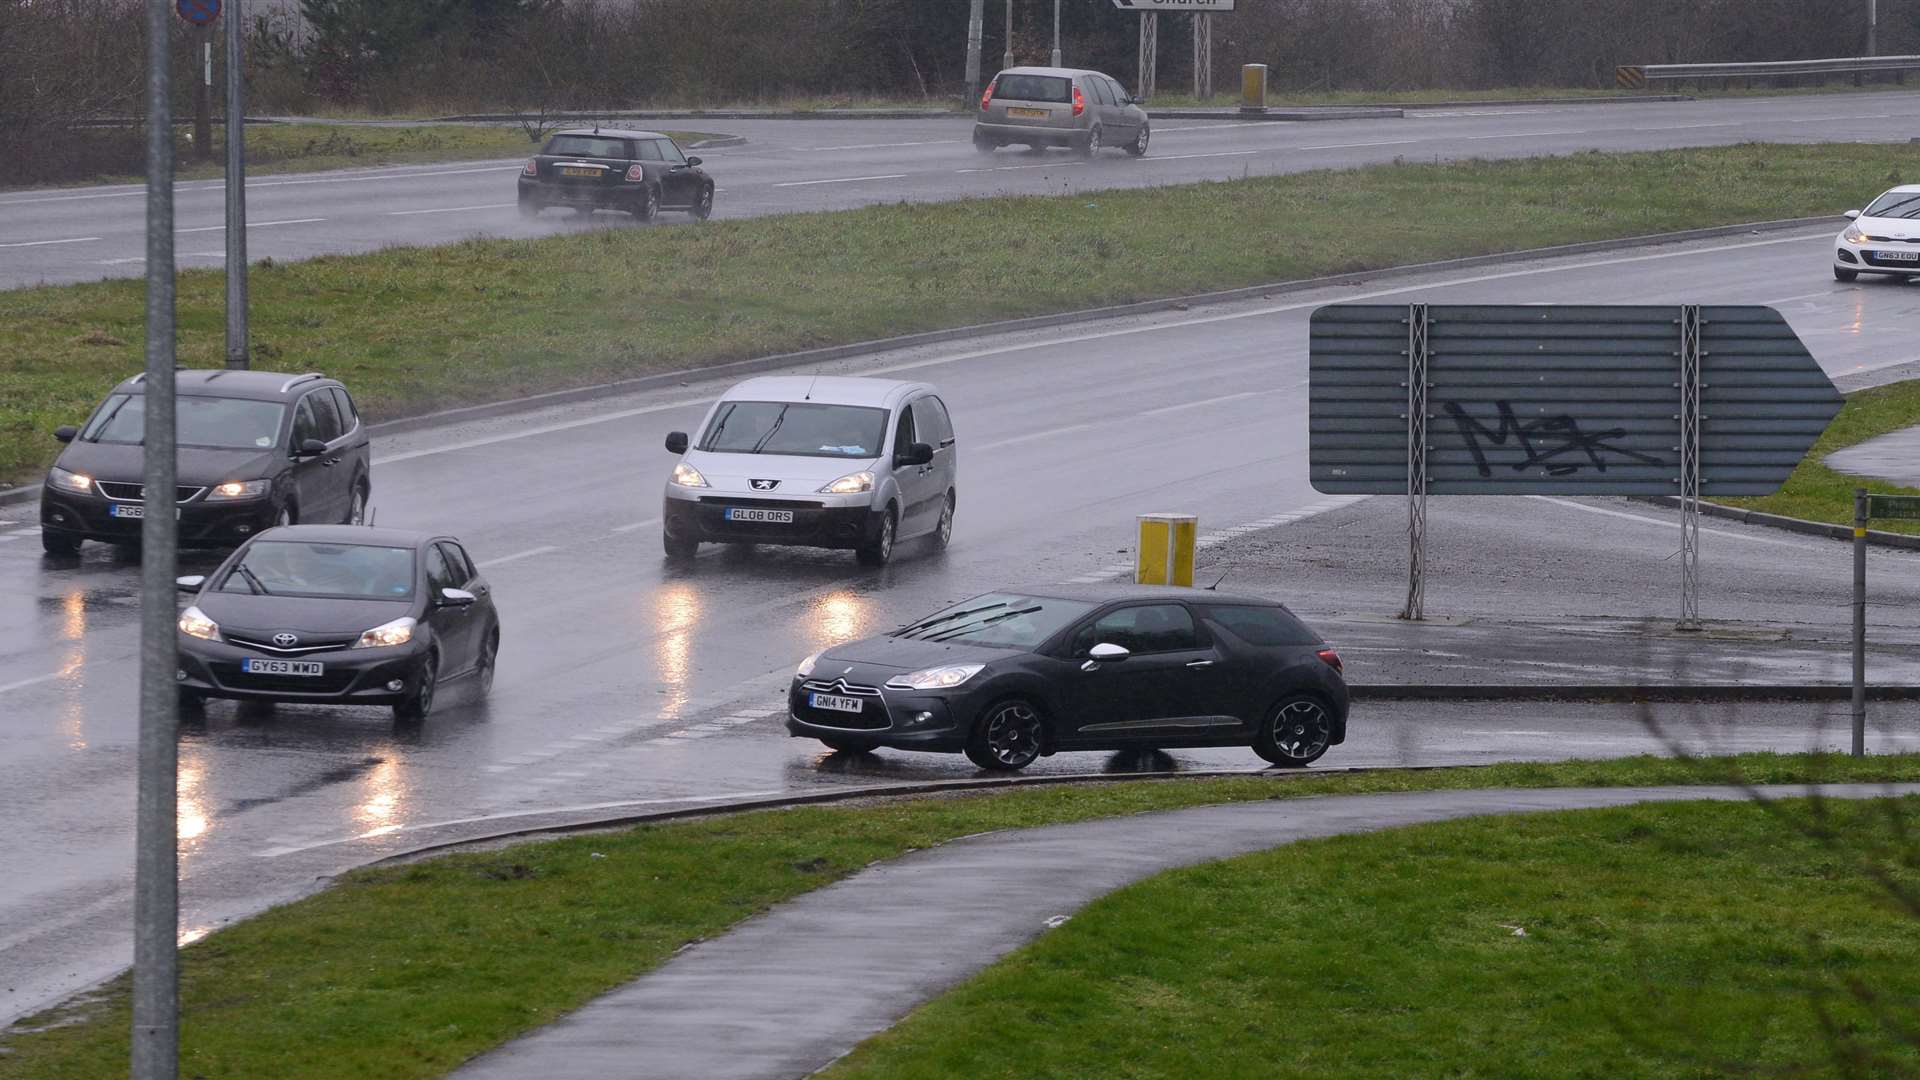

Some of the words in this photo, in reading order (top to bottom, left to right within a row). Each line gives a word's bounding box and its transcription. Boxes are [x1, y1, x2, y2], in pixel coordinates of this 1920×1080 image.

[119, 506, 144, 517] FG6
[733, 510, 764, 520] GL08
[767, 511, 791, 521] ORS
[252, 661, 288, 672] GY63
[292, 663, 320, 674] WWD
